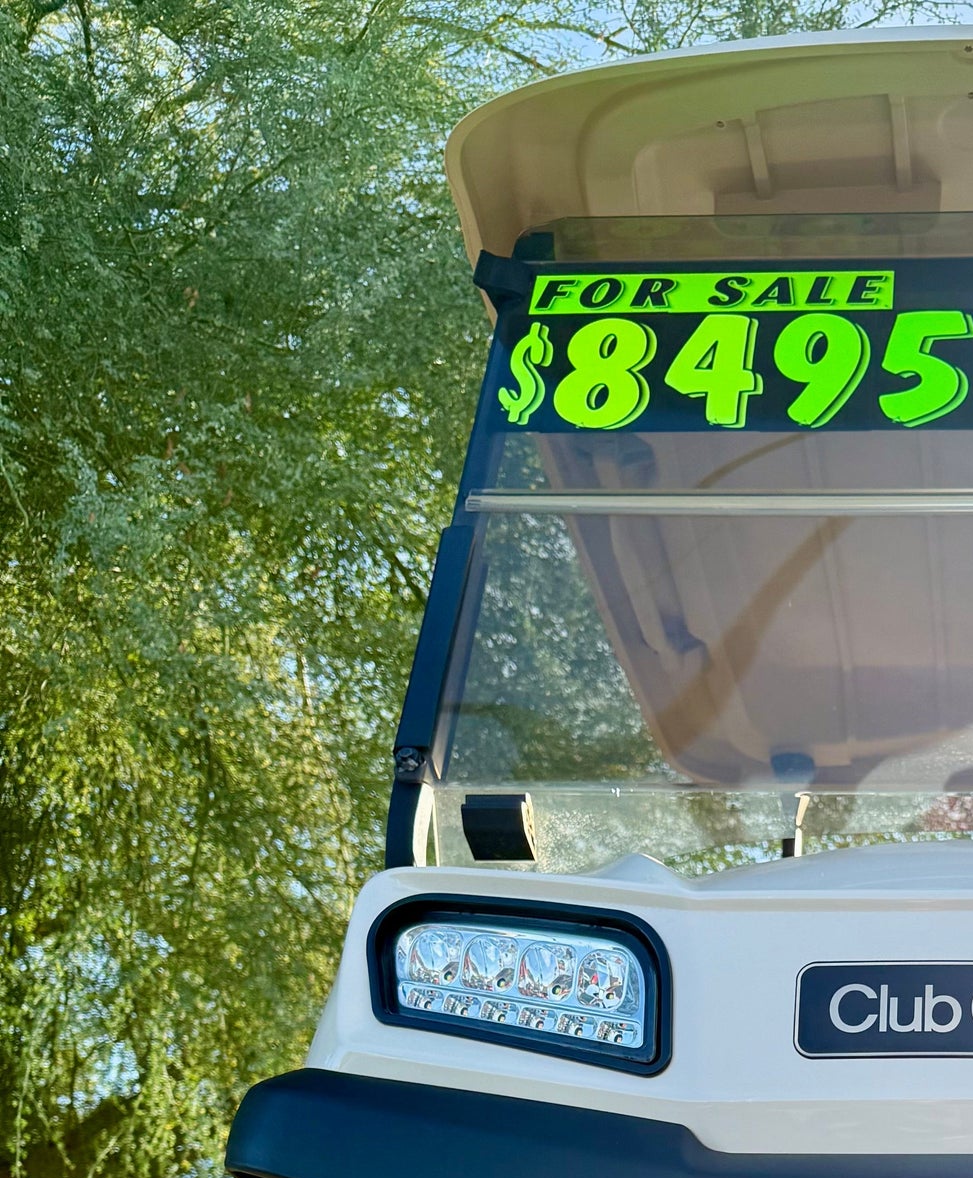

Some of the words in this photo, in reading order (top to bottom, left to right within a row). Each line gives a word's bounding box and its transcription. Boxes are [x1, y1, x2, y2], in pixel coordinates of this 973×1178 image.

[535, 277, 678, 310] FOR
[707, 275, 885, 308] SALE
[829, 983, 962, 1034] Club
